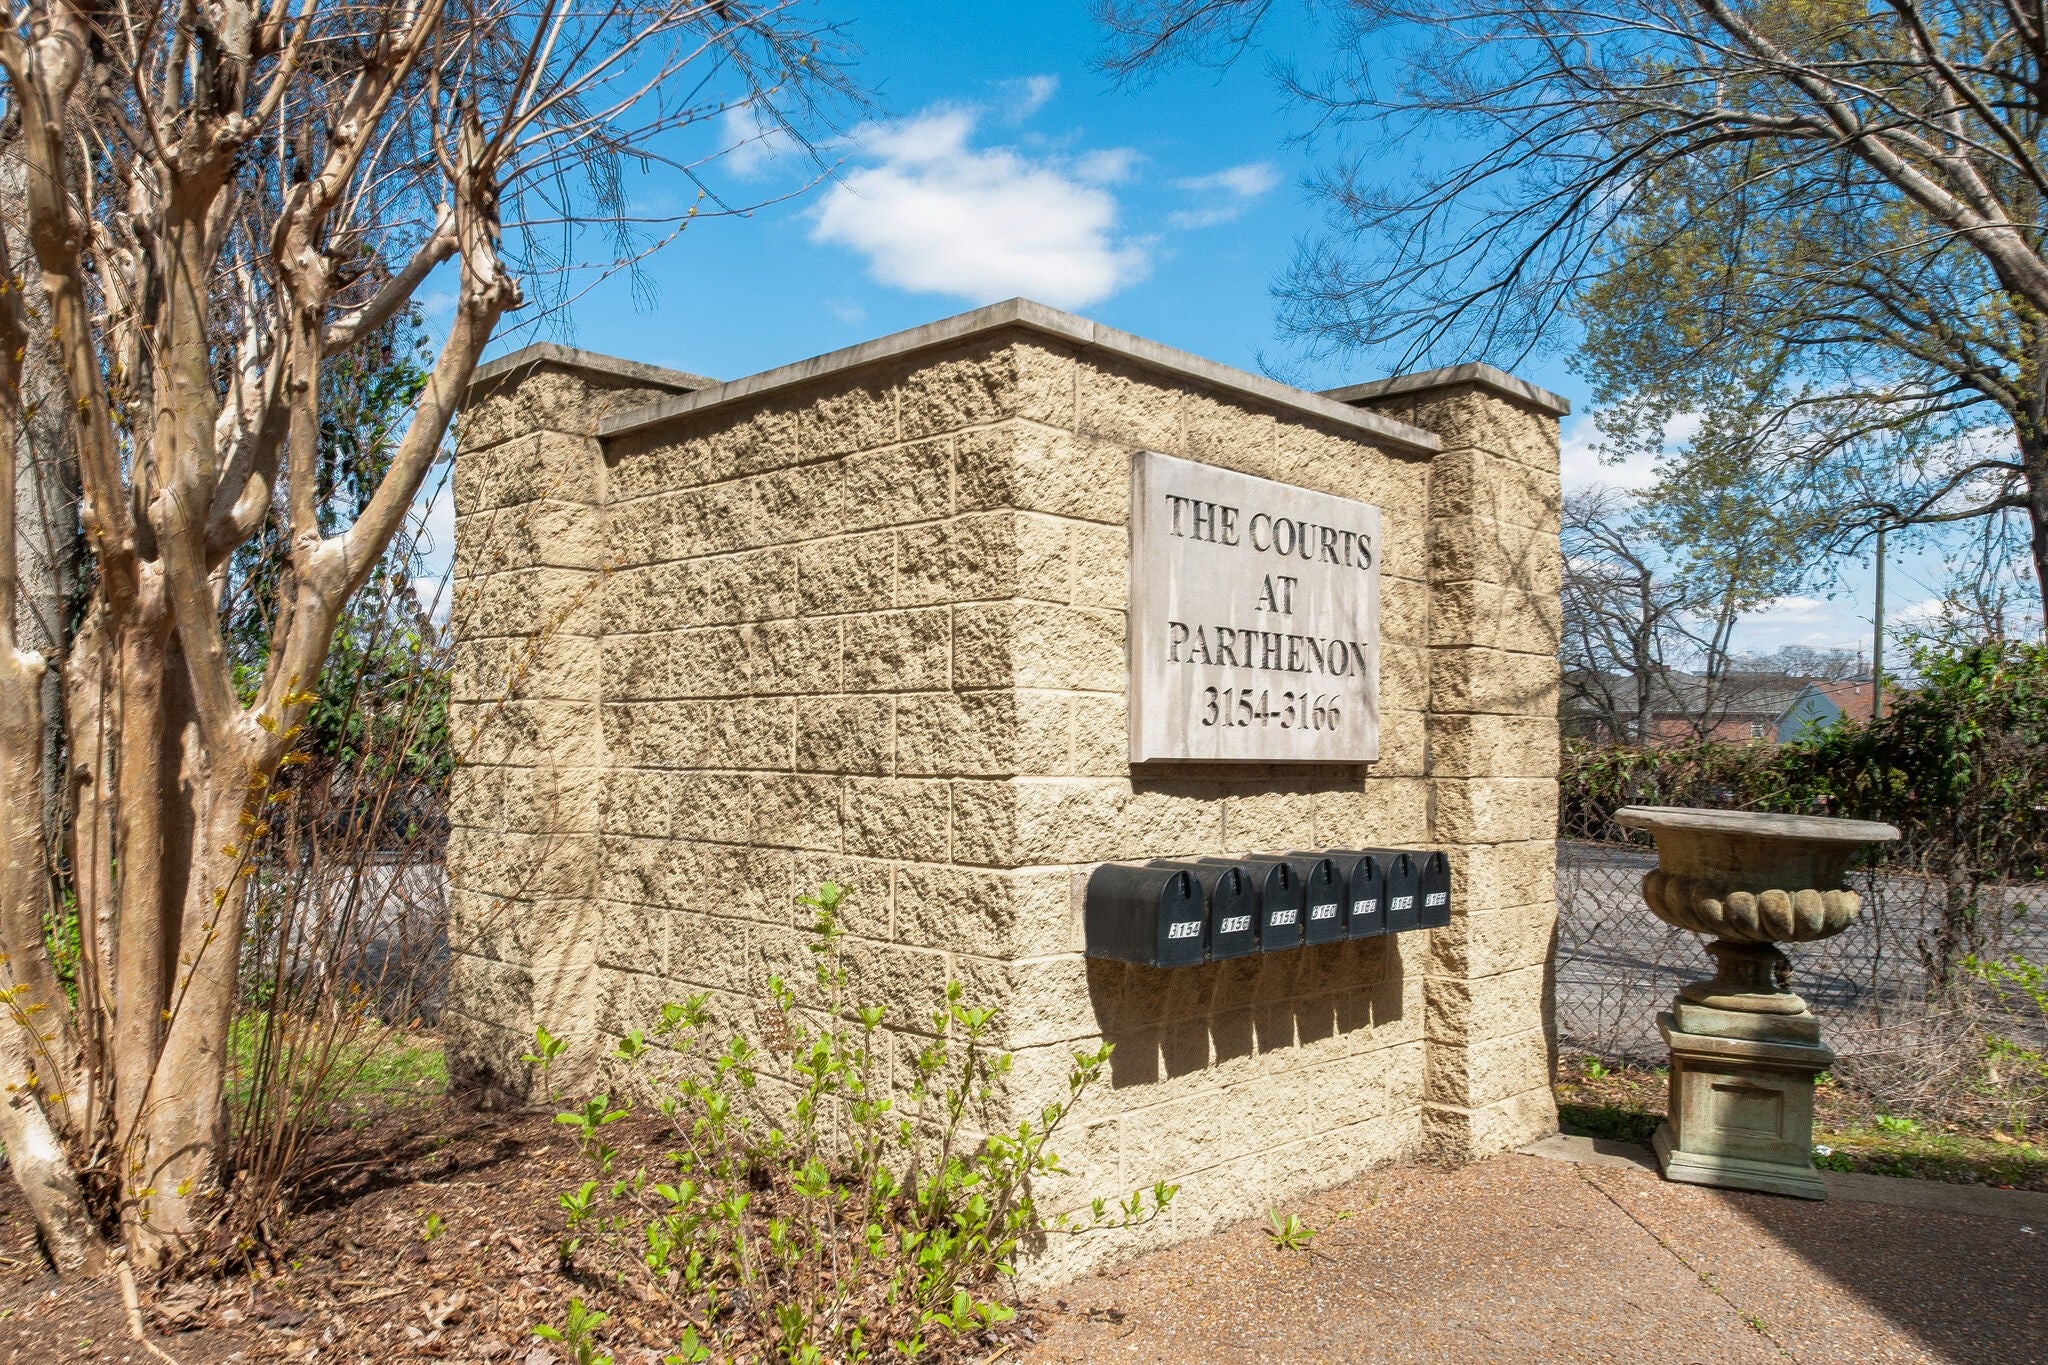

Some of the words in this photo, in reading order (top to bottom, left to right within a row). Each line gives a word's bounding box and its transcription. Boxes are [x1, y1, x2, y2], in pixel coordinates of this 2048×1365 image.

[1165, 494, 1240, 547] THE
[1249, 512, 1373, 570] COURTS
[1254, 573, 1298, 615] AT
[1167, 621, 1368, 678] PARTHENON
[1201, 685, 1342, 731] 3154-3166
[1312, 904, 1337, 919] 3160
[1353, 899, 1376, 914] 3162
[1392, 896, 1413, 910] 3164
[1169, 921, 1200, 938] 3154
[1221, 915, 1250, 932] 3156
